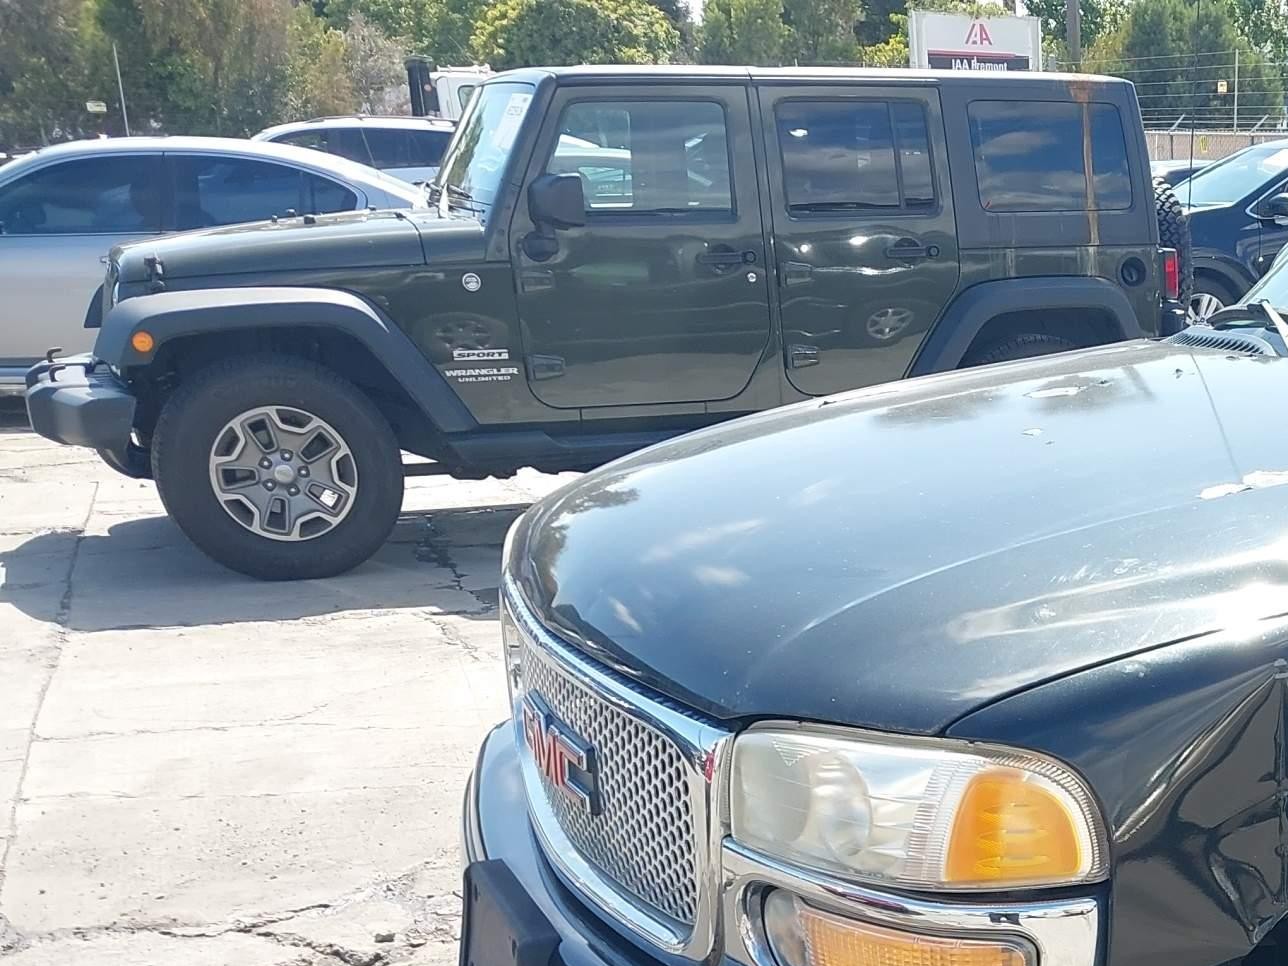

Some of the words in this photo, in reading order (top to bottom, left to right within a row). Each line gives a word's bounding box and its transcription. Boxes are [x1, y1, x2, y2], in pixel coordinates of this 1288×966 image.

[455, 350, 507, 359] SPORT
[444, 367, 519, 377] WRANGLER
[457, 375, 511, 383] UNLIMITED
[522, 694, 594, 815] GMC
